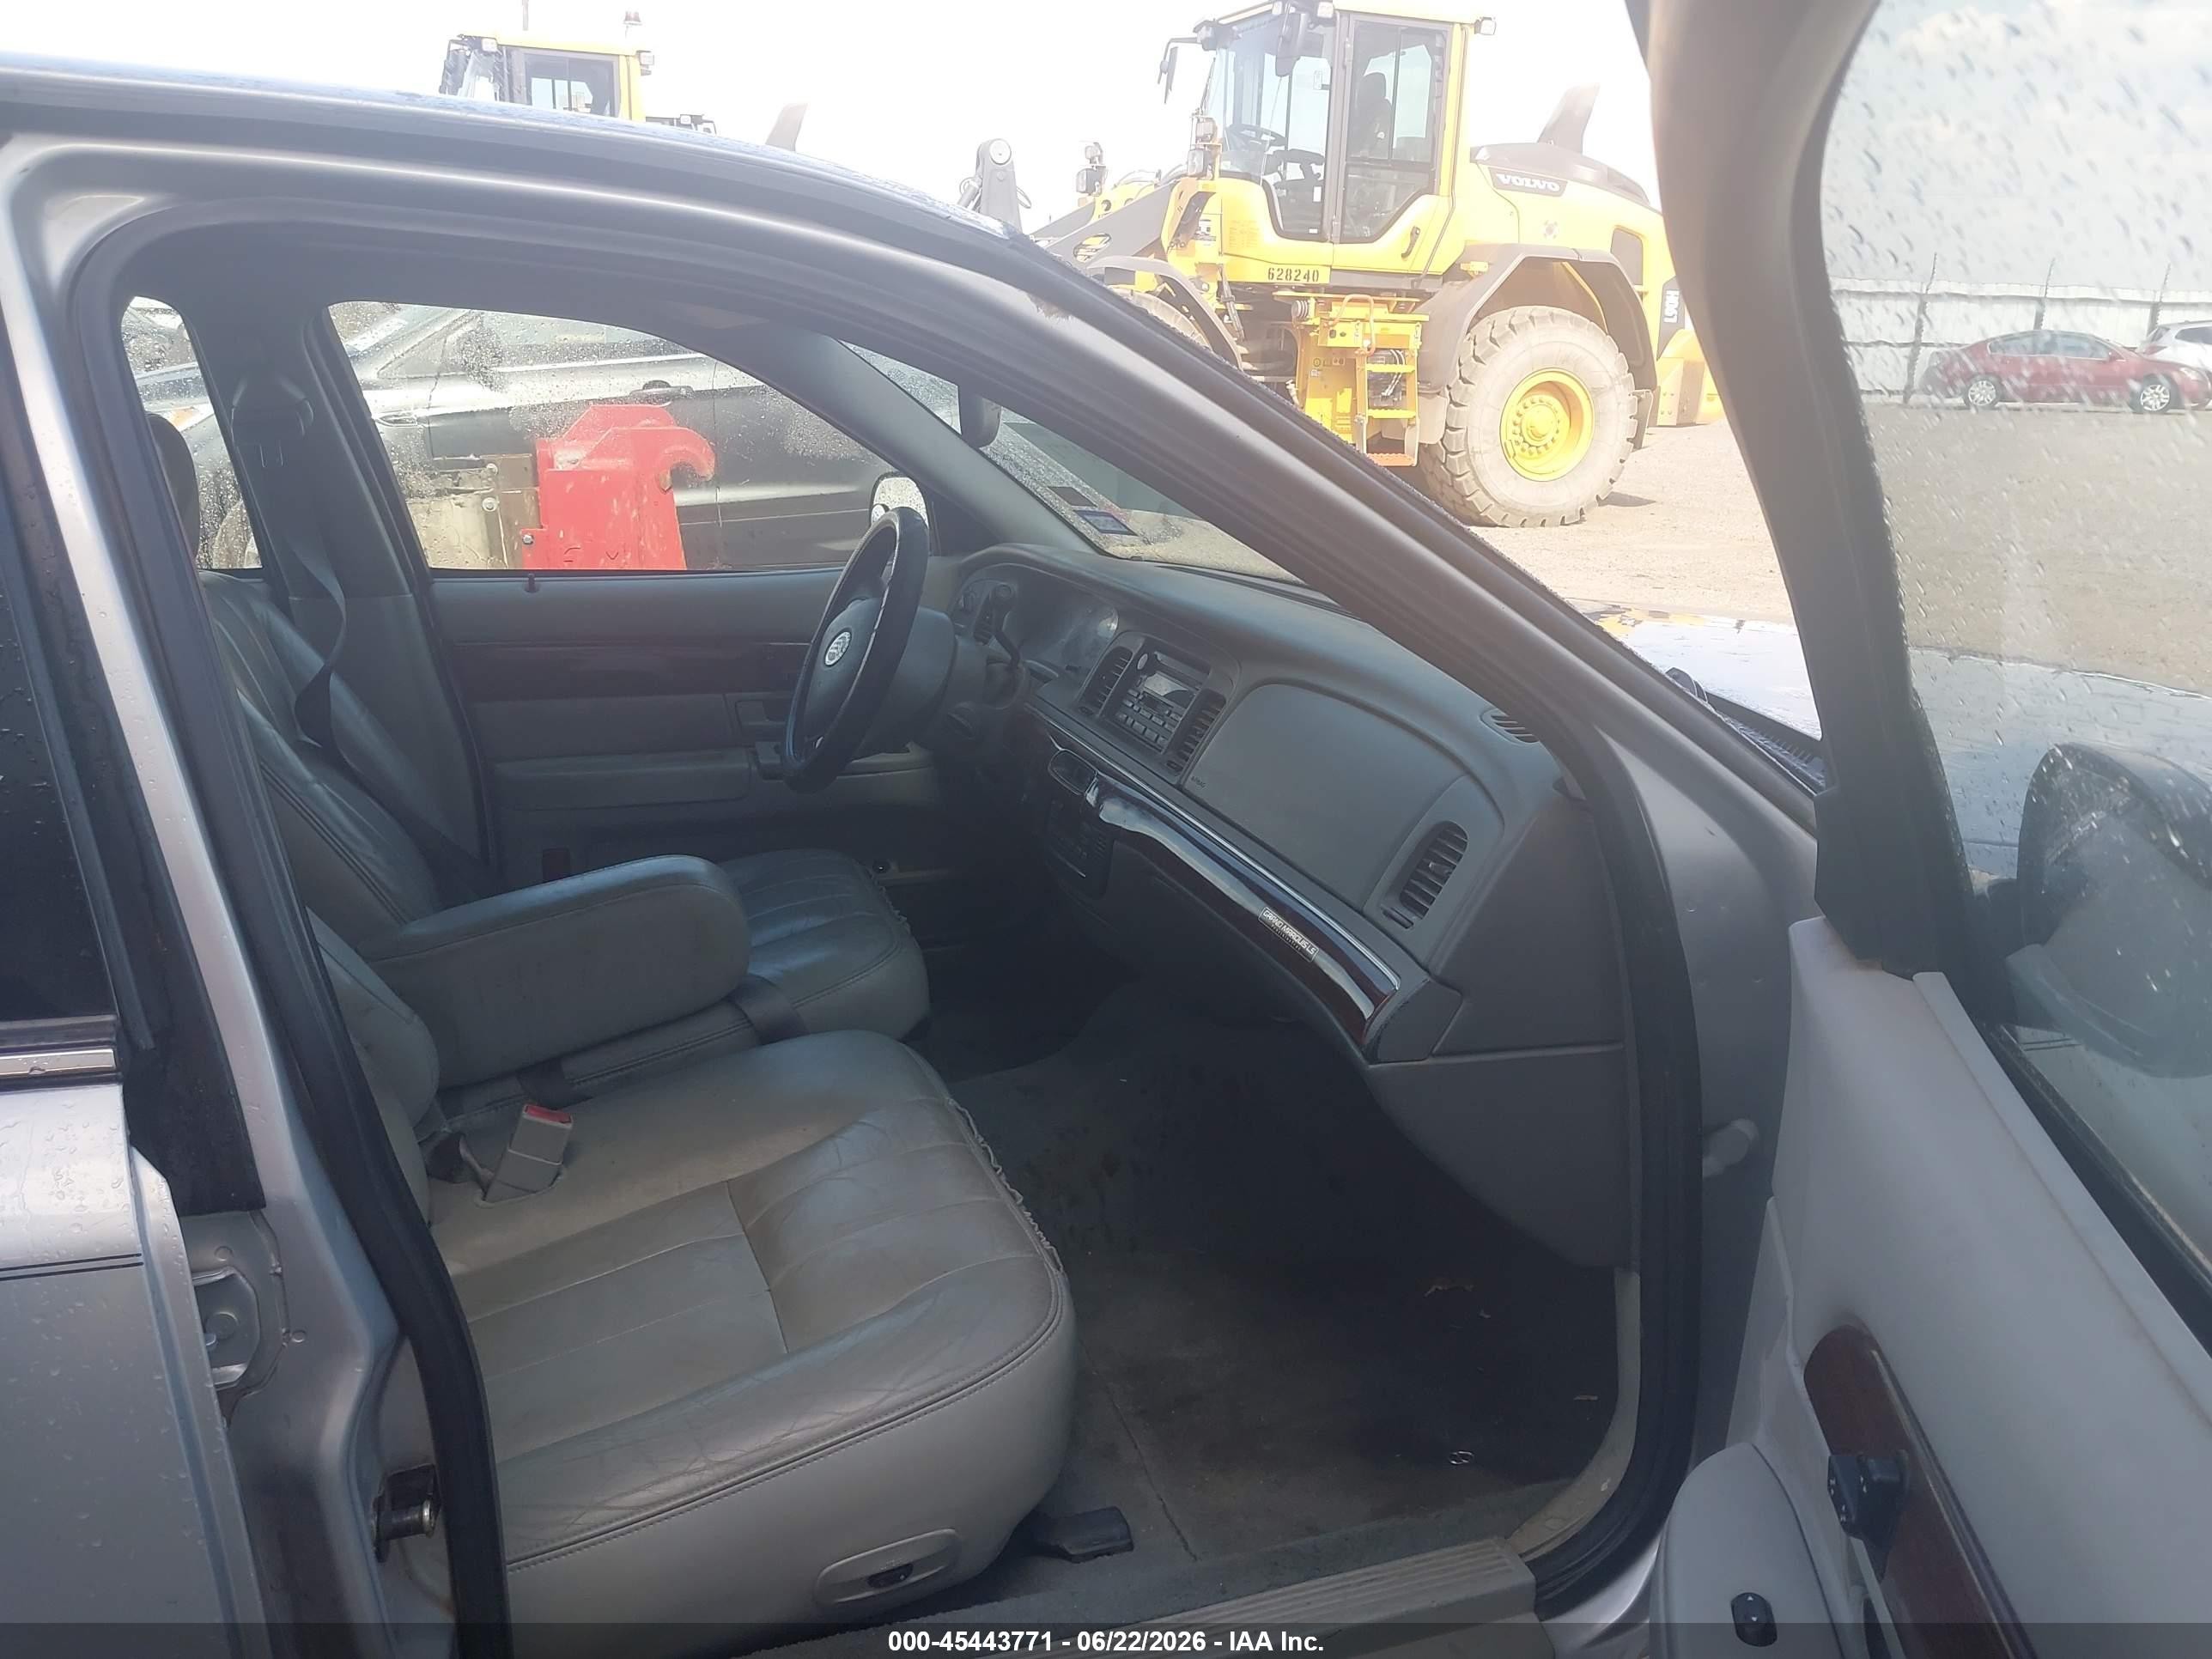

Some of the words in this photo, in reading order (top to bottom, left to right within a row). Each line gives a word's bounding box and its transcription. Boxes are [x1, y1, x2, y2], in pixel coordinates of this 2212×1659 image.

[1496, 173, 1560, 192] VOLVO
[1267, 267, 1320, 283] 628240
[1262, 909, 1284, 928] GRAND
[1282, 925, 1310, 949] MARQUIS
[1306, 944, 1316, 955] LS
